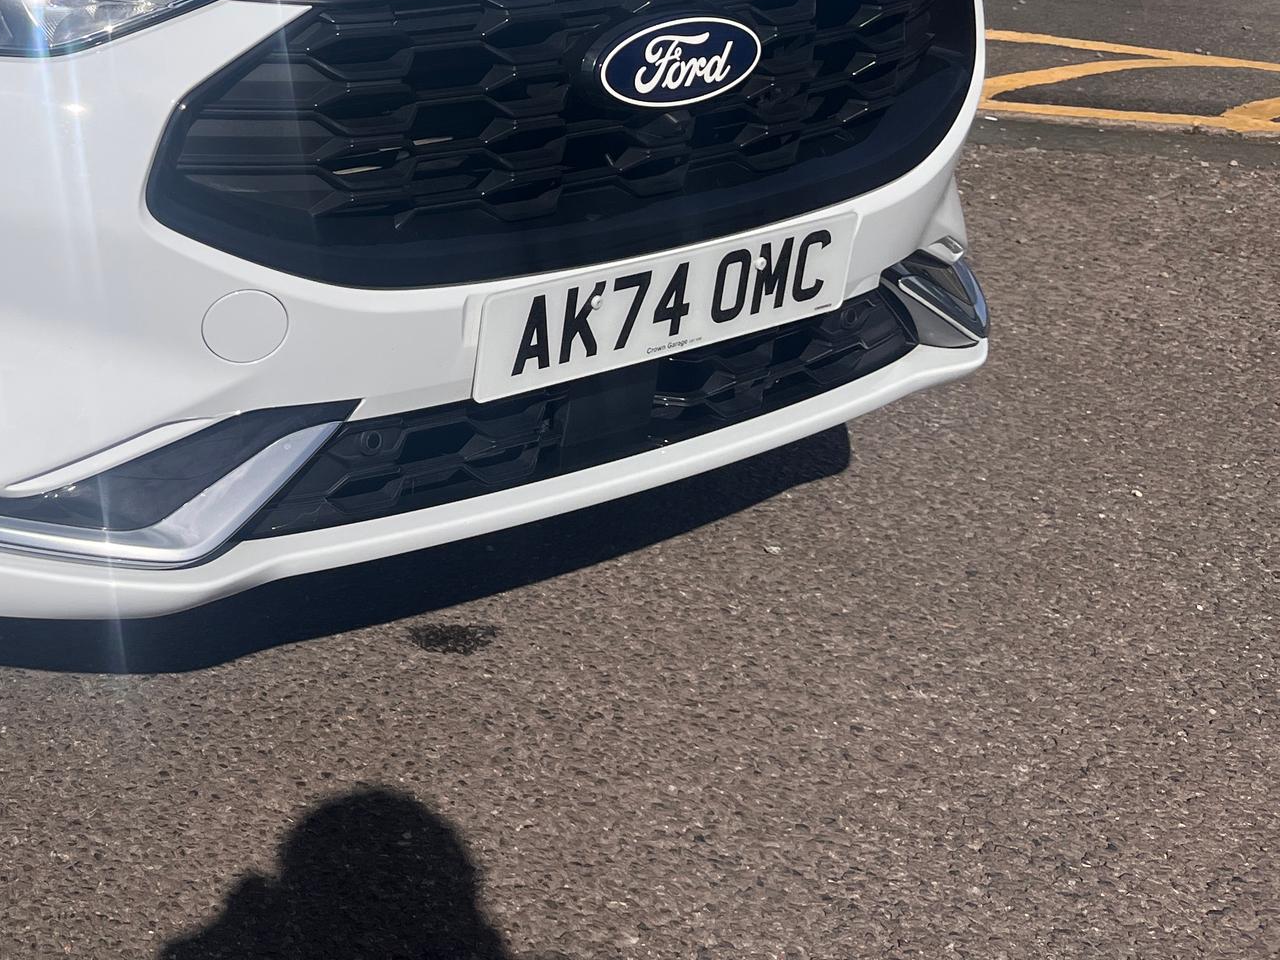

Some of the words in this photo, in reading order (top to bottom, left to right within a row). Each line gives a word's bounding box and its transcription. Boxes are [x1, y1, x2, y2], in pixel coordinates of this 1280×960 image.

[634, 31, 734, 94] Ford
[510, 261, 690, 377] AK74
[710, 229, 832, 324] OMC
[646, 344, 667, 355] Crown
[667, 338, 688, 349] Garage
